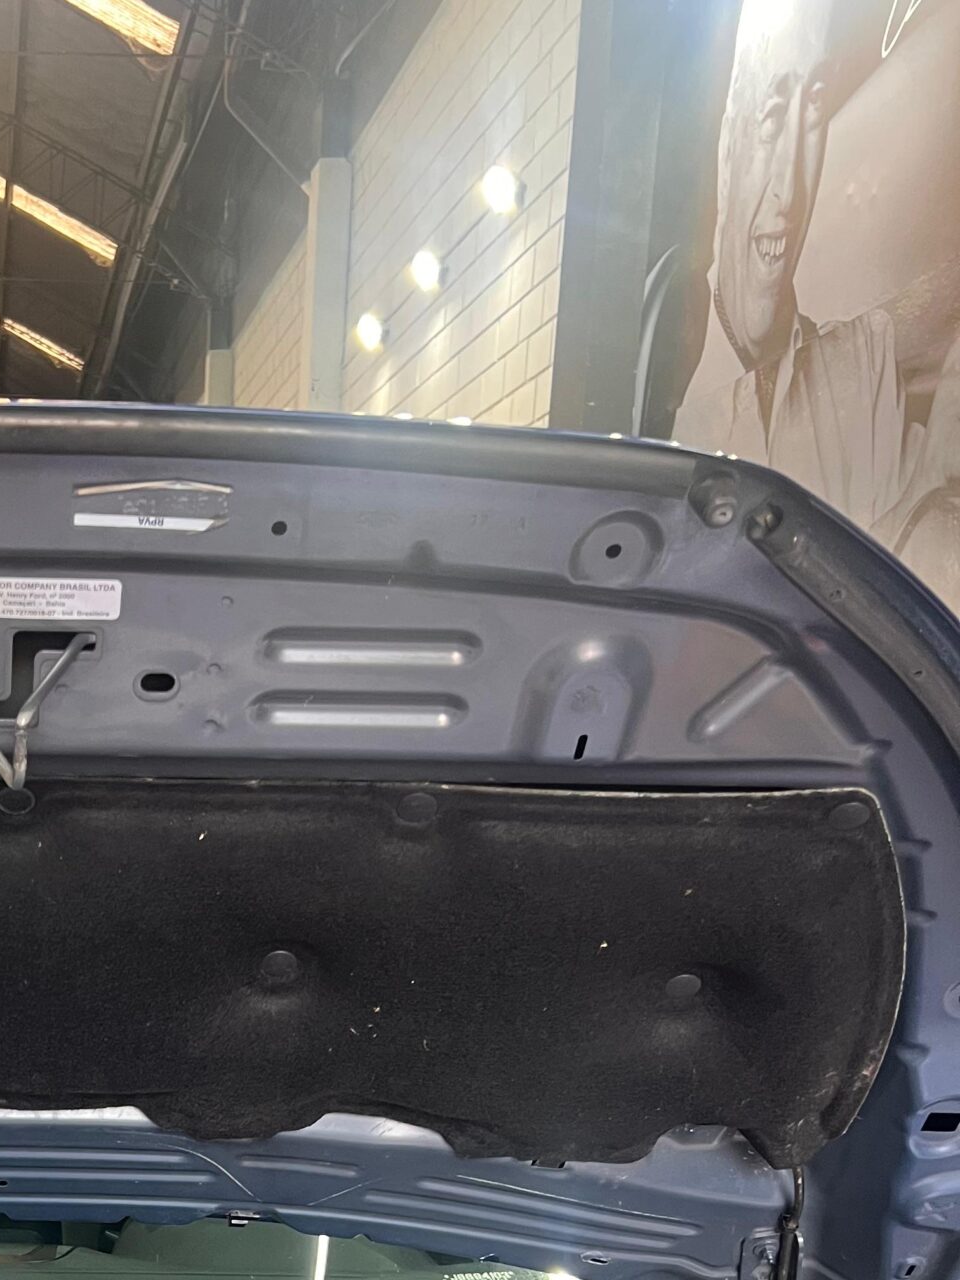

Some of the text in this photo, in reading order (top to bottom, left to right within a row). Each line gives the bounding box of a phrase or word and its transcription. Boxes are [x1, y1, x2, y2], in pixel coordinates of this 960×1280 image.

[138, 517, 164, 527] RPVA
[14, 582, 57, 591] COMPANY
[59, 583, 91, 592] BRASIL
[93, 584, 116, 592] LTDA
[7, 592, 27, 600] Henry
